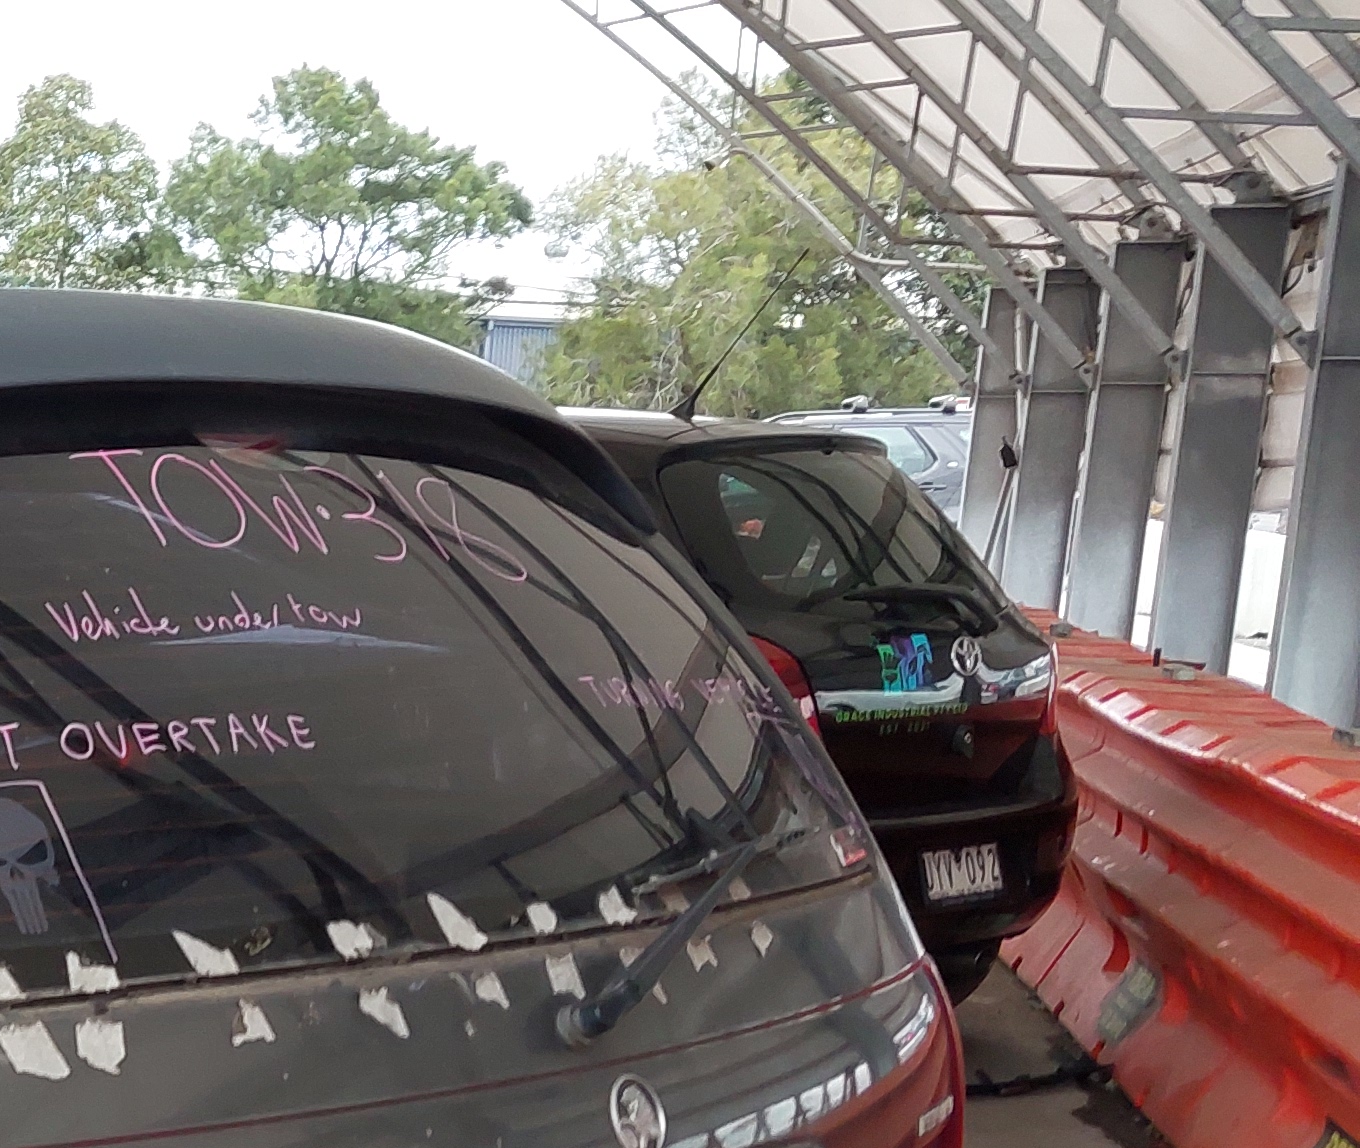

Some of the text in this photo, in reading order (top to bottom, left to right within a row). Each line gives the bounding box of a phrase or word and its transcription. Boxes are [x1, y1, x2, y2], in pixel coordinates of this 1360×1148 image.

[44, 587, 180, 643] Vehicle
[287, 593, 363, 629] tow
[60, 713, 316, 761] OVERTAKE
